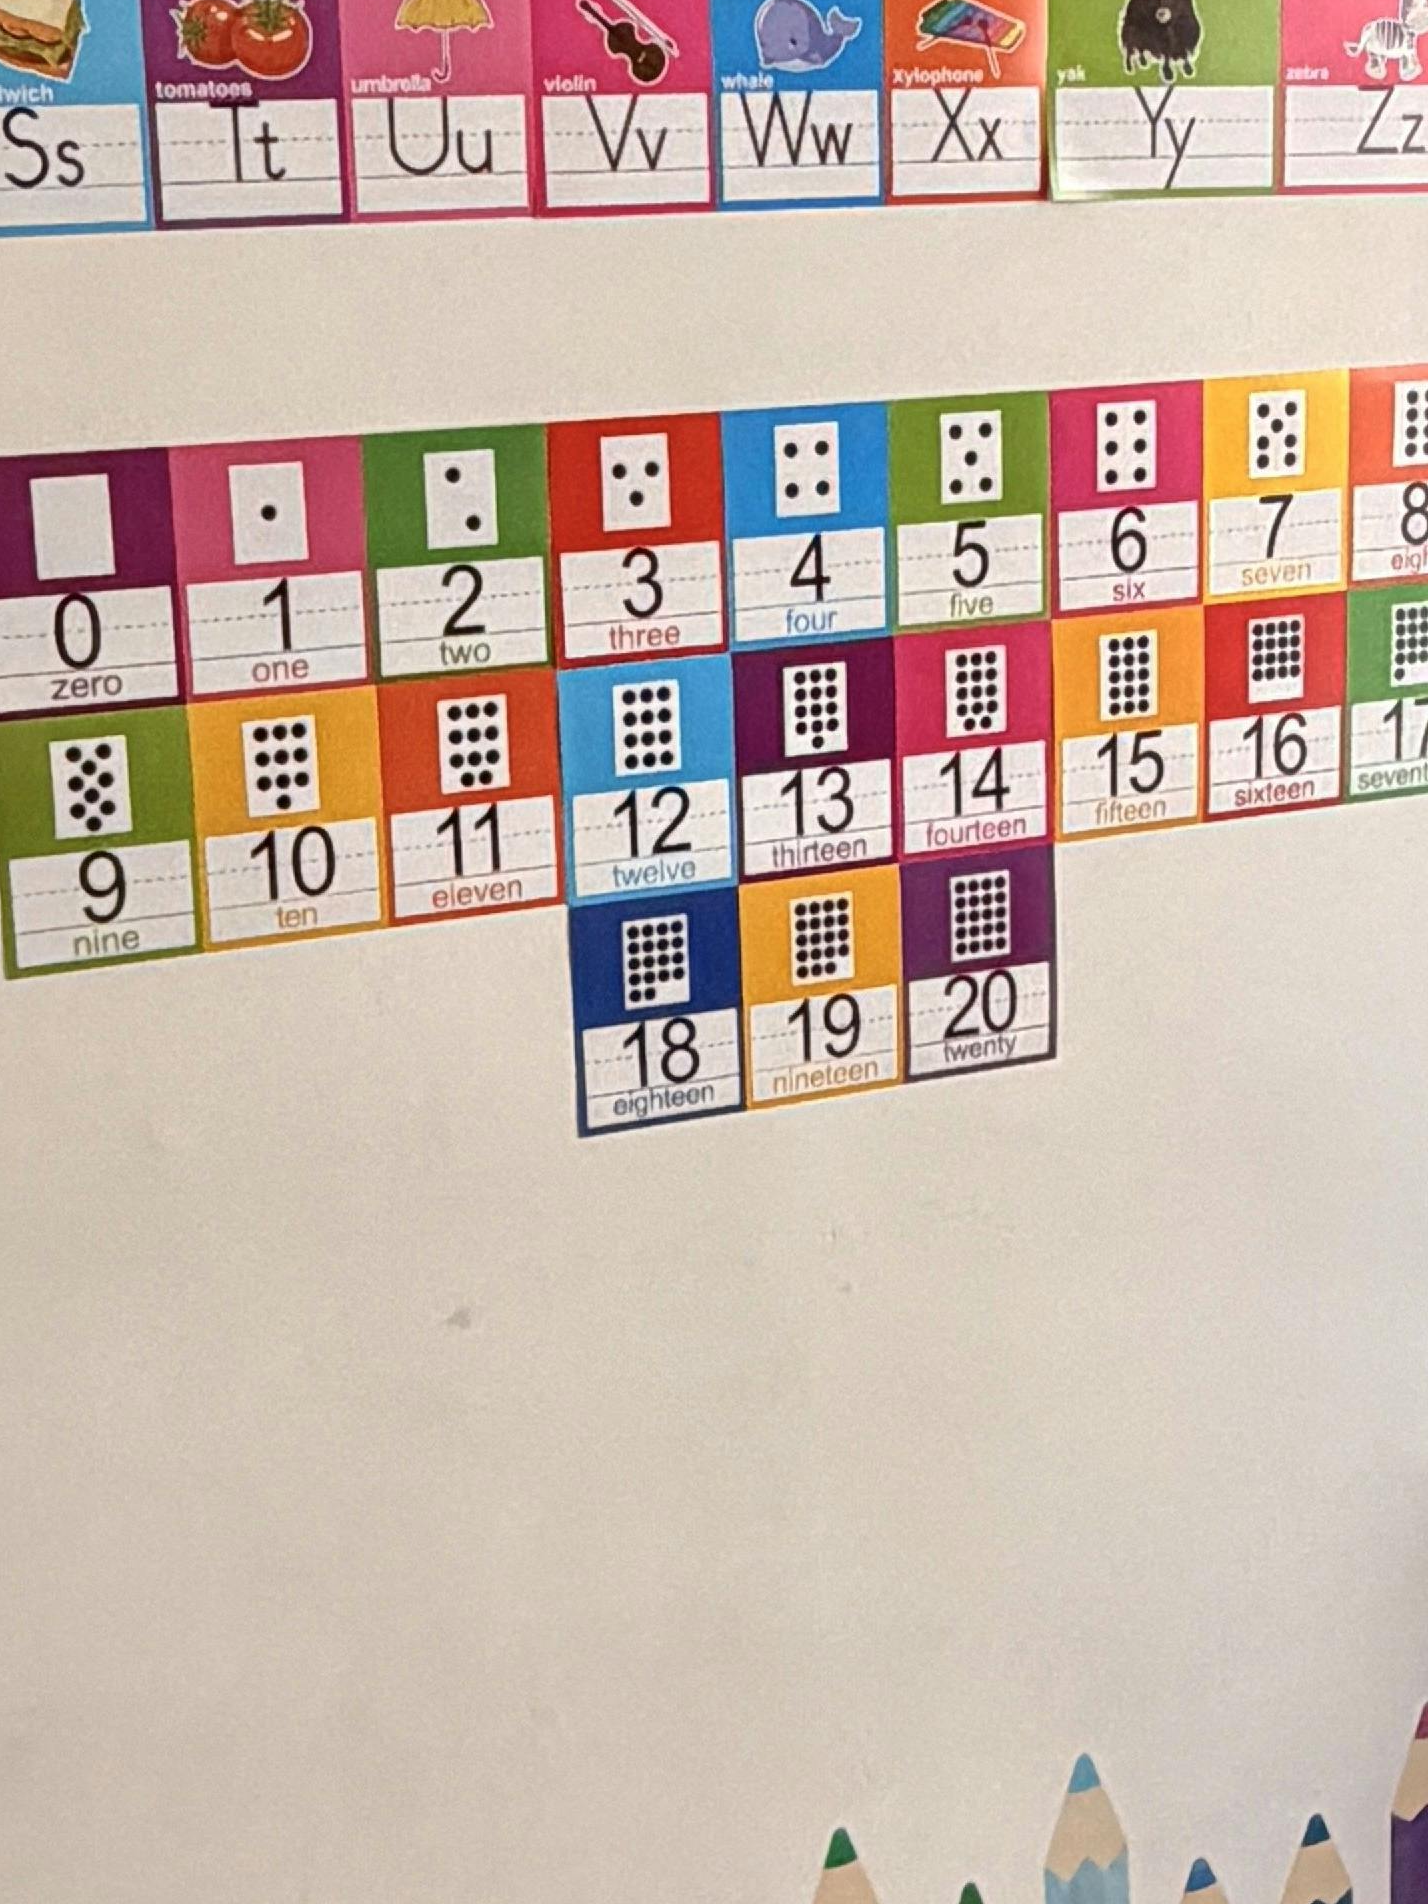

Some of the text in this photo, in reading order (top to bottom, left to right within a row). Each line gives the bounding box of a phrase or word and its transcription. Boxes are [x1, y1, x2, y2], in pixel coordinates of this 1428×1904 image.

[155, 80, 252, 98] tomatoes
[351, 74, 432, 92] umbrella
[544, 76, 596, 92] violin
[722, 74, 773, 89] whale
[893, 68, 984, 86] xylophone
[1057, 67, 1085, 85] yak
[4, 107, 85, 188] Ss
[209, 98, 286, 181] Tt
[388, 97, 493, 175] Uu
[585, 94, 668, 170] Vv
[740, 90, 853, 166] Ww
[932, 89, 1003, 161] Xx
[1134, 86, 1195, 188] Yy
[1358, 86, 1425, 153] Zz
[953, 521, 989, 588] 5
[1111, 506, 1146, 573] 6
[1259, 495, 1293, 558] 7
[622, 547, 662, 617] 3
[790, 534, 831, 601] 4
[1113, 578, 1145, 601] six
[1242, 562, 1311, 585] seven
[54, 593, 101, 669] 0
[263, 578, 292, 651] 1
[442, 565, 485, 635] 2
[786, 608, 837, 634] four
[950, 591, 993, 616] five
[252, 656, 309, 681] one
[441, 639, 491, 665] two
[609, 624, 681, 649] three
[51, 671, 122, 700] zero
[1097, 731, 1164, 796] 15
[1243, 713, 1306, 778] 16
[780, 767, 854, 835] 13
[940, 748, 1010, 815] 14
[1095, 798, 1166, 824] fifteen
[1235, 780, 1315, 806] sixteen
[437, 804, 500, 876] 11
[614, 787, 691, 857] 12
[773, 838, 867, 868] thirteen
[927, 816, 1026, 846] fourteen
[79, 850, 126, 923] 9
[250, 826, 335, 900] 10
[432, 881, 522, 909] eleven
[613, 857, 695, 886] twelve
[74, 928, 139, 954] nine
[276, 905, 317, 928] ten
[788, 994, 859, 1062] 19
[944, 971, 1016, 1039] 20
[623, 1017, 699, 1087] 18
[773, 1060, 878, 1094] nineteen
[944, 1036, 1017, 1062] twenty
[614, 1084, 715, 1117] eighteen
